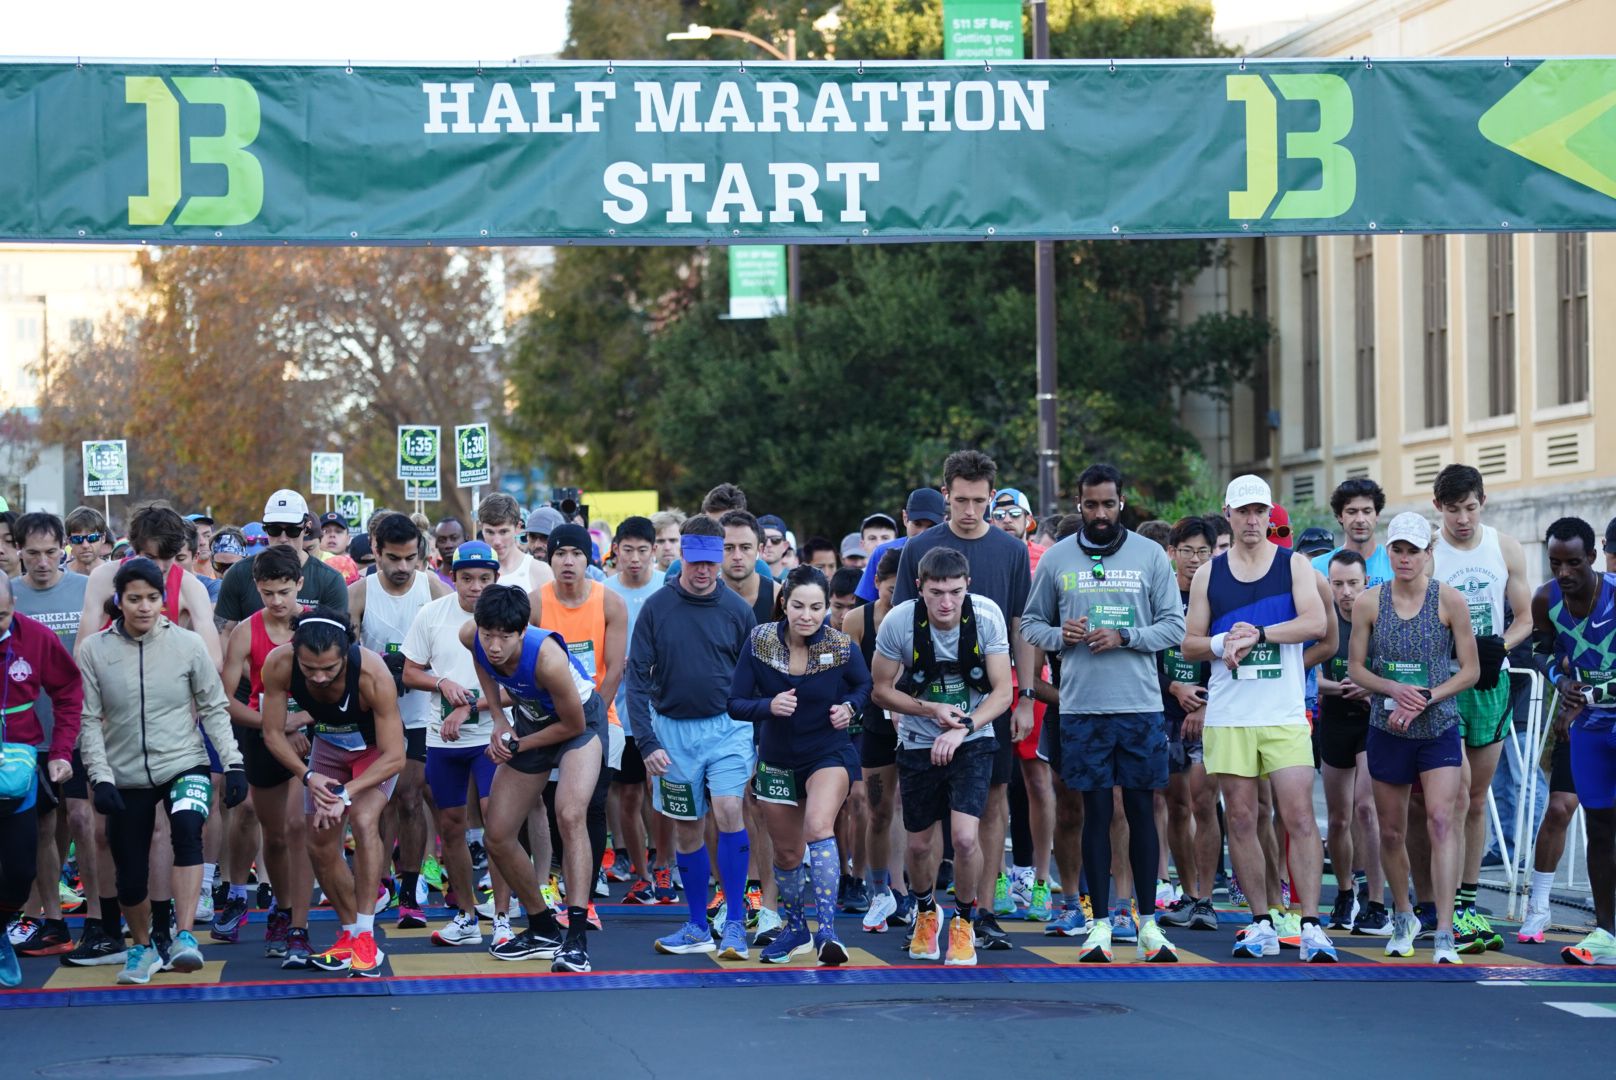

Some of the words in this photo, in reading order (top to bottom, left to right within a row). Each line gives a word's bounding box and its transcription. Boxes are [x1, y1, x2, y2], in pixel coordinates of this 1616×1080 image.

[952, 18, 971, 29] 511
[973, 18, 988, 29] SF
[952, 32, 993, 46] Getting
[993, 34, 1015, 46] you
[955, 47, 994, 57] around
[994, 47, 1013, 57] the
[423, 81, 616, 135] HALF
[635, 79, 1050, 134] MARATHON
[602, 161, 880, 225] START
[406, 437, 432, 452] 1:35
[463, 436, 484, 454] 1:30
[91, 451, 119, 467] 1:35
[460, 469, 487, 477] BERKELEY
[340, 502, 358, 515] 1:40
[1079, 570, 1141, 580] BEKELEY
[1466, 567, 1498, 582] BASEMENT
[1100, 580, 1141, 588] MARATHON
[30, 611, 83, 622] ERKELEY
[47, 622, 80, 630] MARATHO
[1472, 626, 1484, 635] 91
[1251, 650, 1273, 661] 767
[1175, 669, 1194, 680] 726
[186, 788, 207, 801] 686
[769, 786, 790, 797] 526
[670, 801, 688, 813] 523
